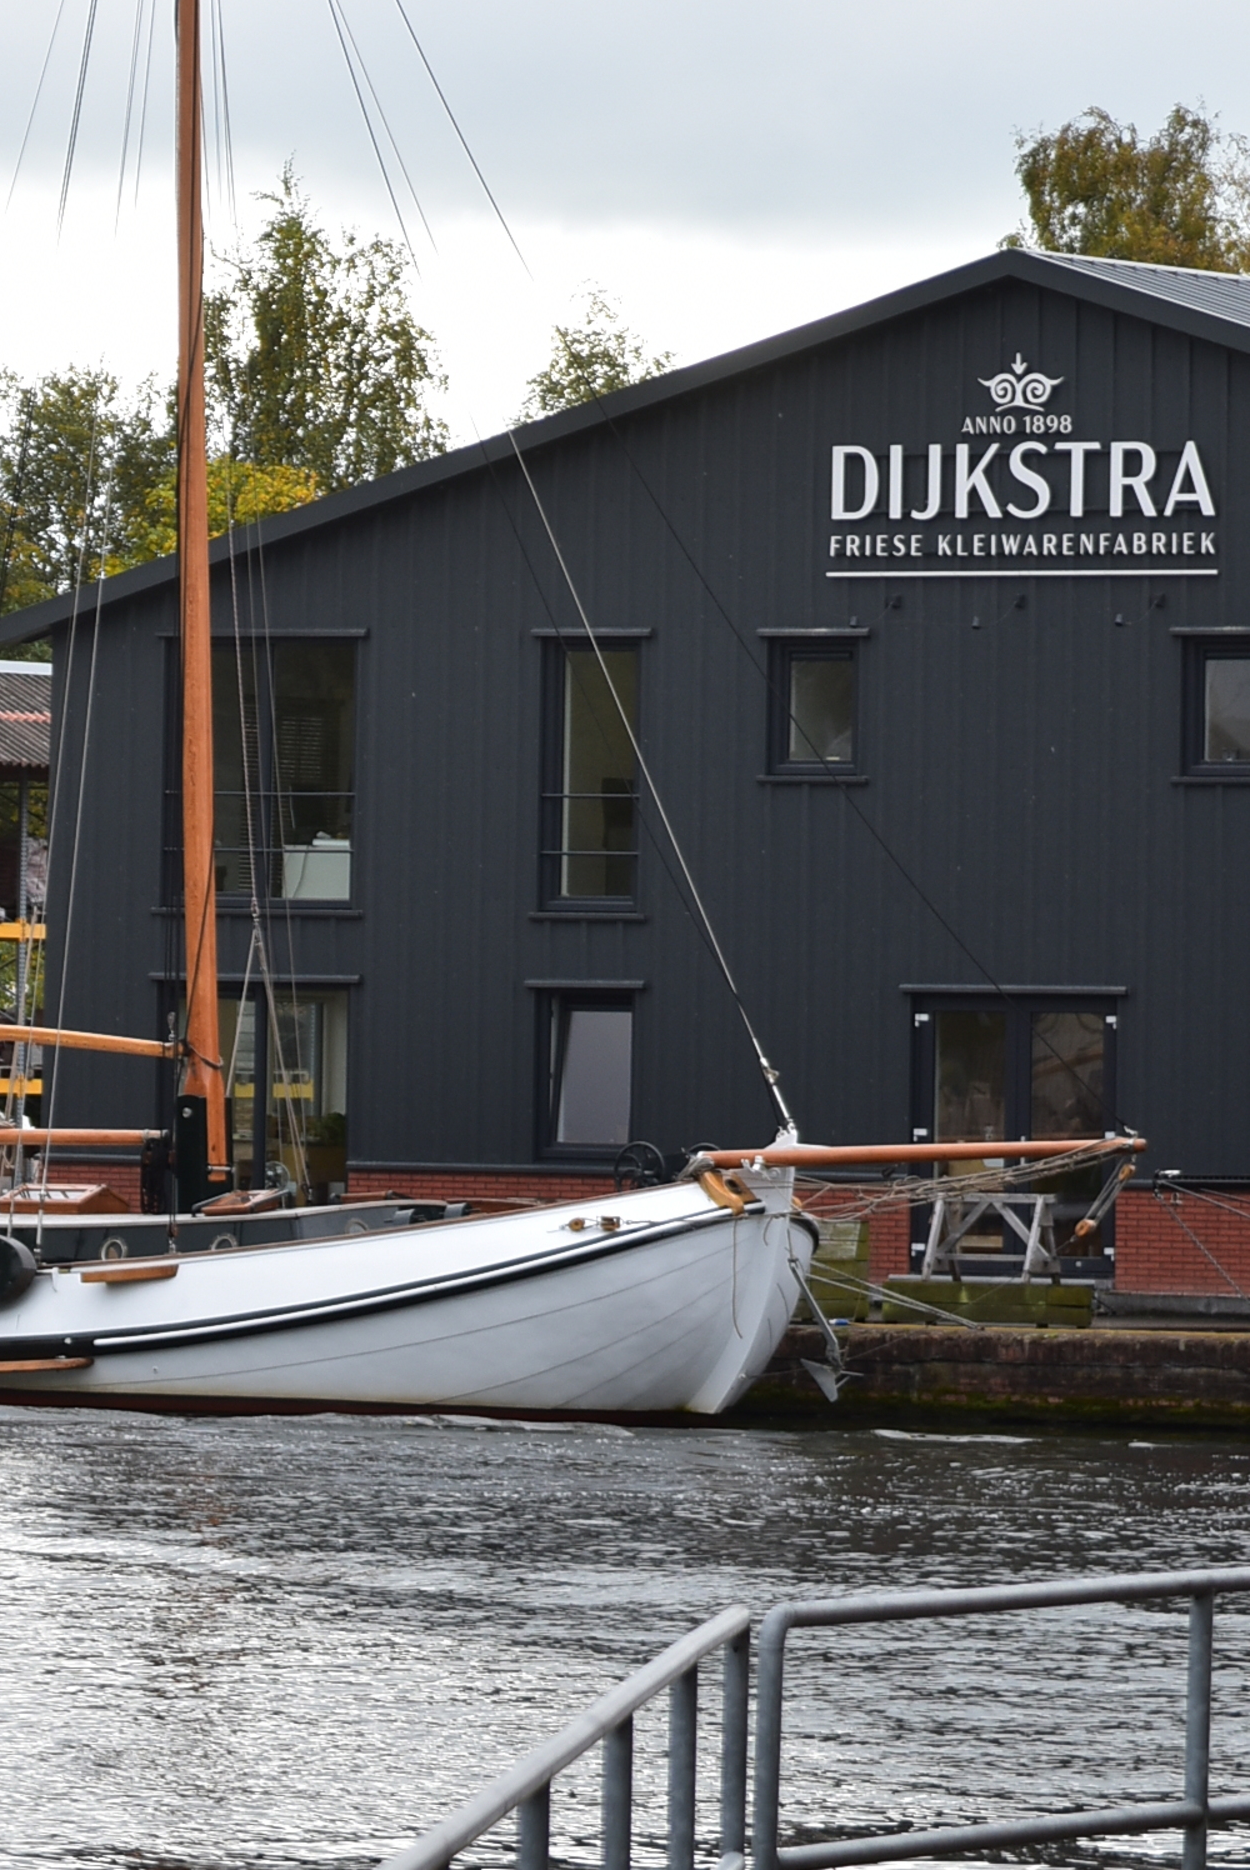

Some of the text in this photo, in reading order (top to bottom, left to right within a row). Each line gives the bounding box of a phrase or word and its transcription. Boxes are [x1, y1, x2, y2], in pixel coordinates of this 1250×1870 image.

[961, 414, 1073, 435] ANNO 1898
[831, 440, 1216, 520] DIJKSTRA
[829, 531, 1216, 557] FRIESE KLEIWARENFABRIEK
